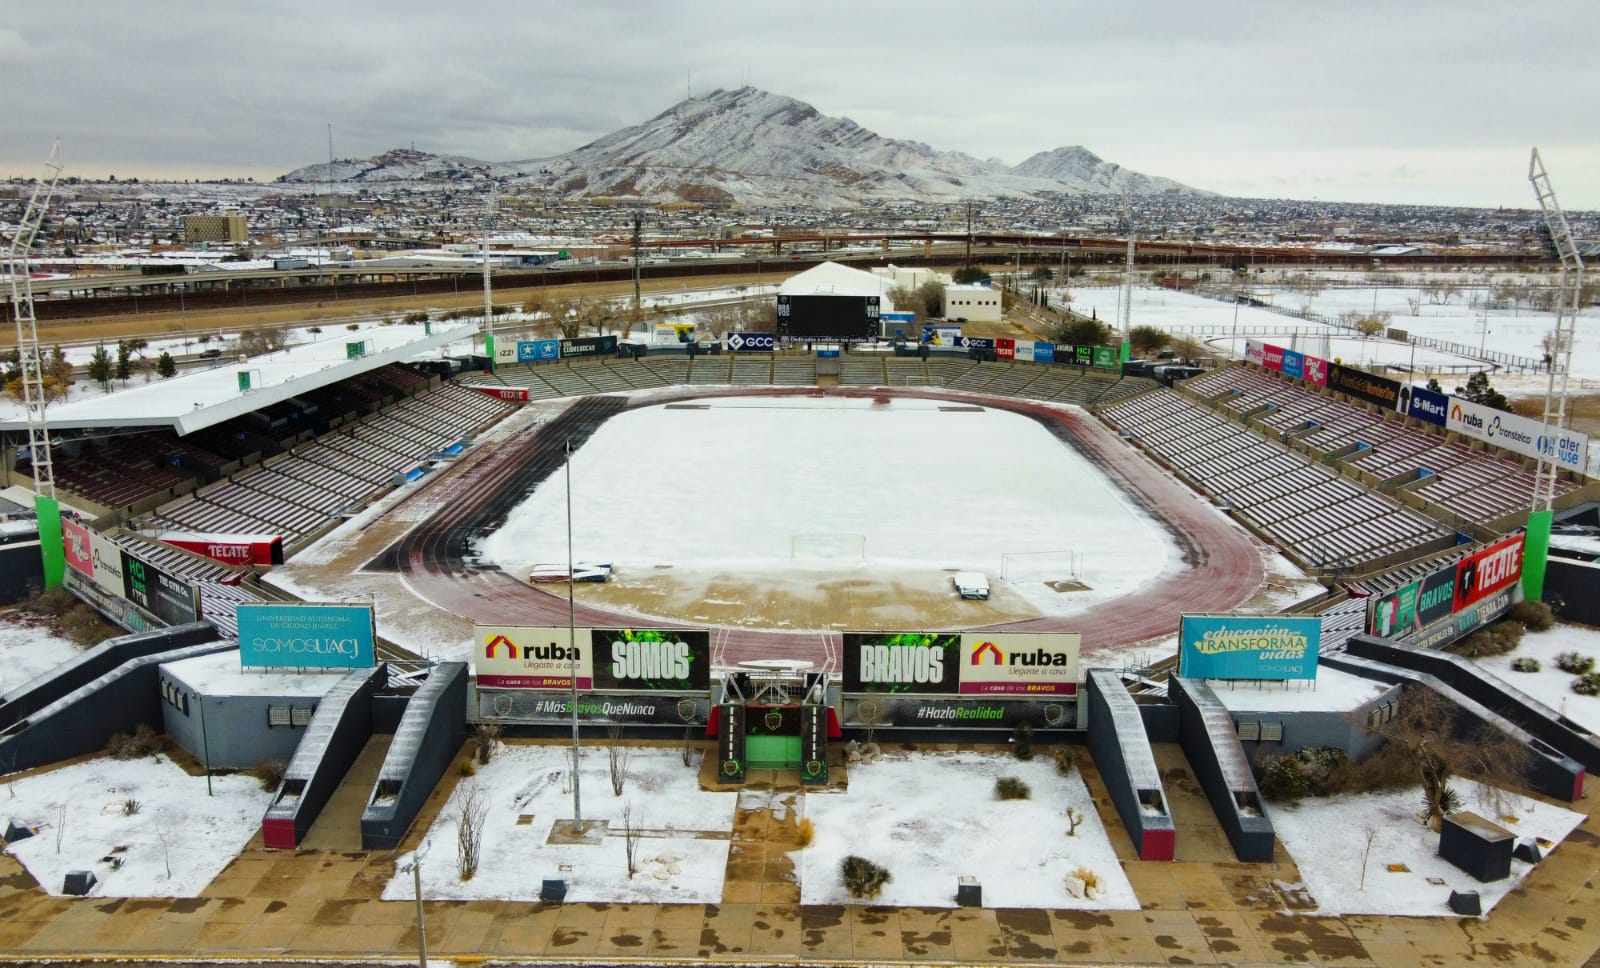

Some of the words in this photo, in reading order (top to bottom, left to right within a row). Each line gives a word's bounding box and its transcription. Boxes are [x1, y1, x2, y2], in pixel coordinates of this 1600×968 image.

[745, 337, 773, 347] GCC
[970, 340, 987, 348] GCC
[1076, 347, 1091, 356] HCI
[1305, 358, 1320, 369] Del
[1463, 413, 1483, 428] ruba
[1499, 426, 1531, 445] transtelco
[208, 544, 250, 557] TECATE
[129, 558, 145, 581] HCI
[1478, 542, 1521, 591] TECATE
[1420, 580, 1454, 612] BRAVOS
[256, 615, 307, 623] UNIVERSIDAD
[281, 622, 311, 630] CIUDAD
[1203, 624, 1289, 641] educación
[252, 637, 359, 659] SOMOSUACJ
[523, 642, 581, 660] ruba
[1199, 637, 1305, 651] TRANSFORMA
[611, 641, 690, 680] SOMOS
[1009, 648, 1067, 667] ruba
[1259, 650, 1305, 660] vidas
[523, 661, 554, 671] Llegaste
[860, 644, 944, 684] BRAVOS
[1008, 667, 1040, 676] Llegaste
[535, 701, 656, 715] #MásBavosQueNunca
[917, 706, 1005, 719] #HazloRealidad
